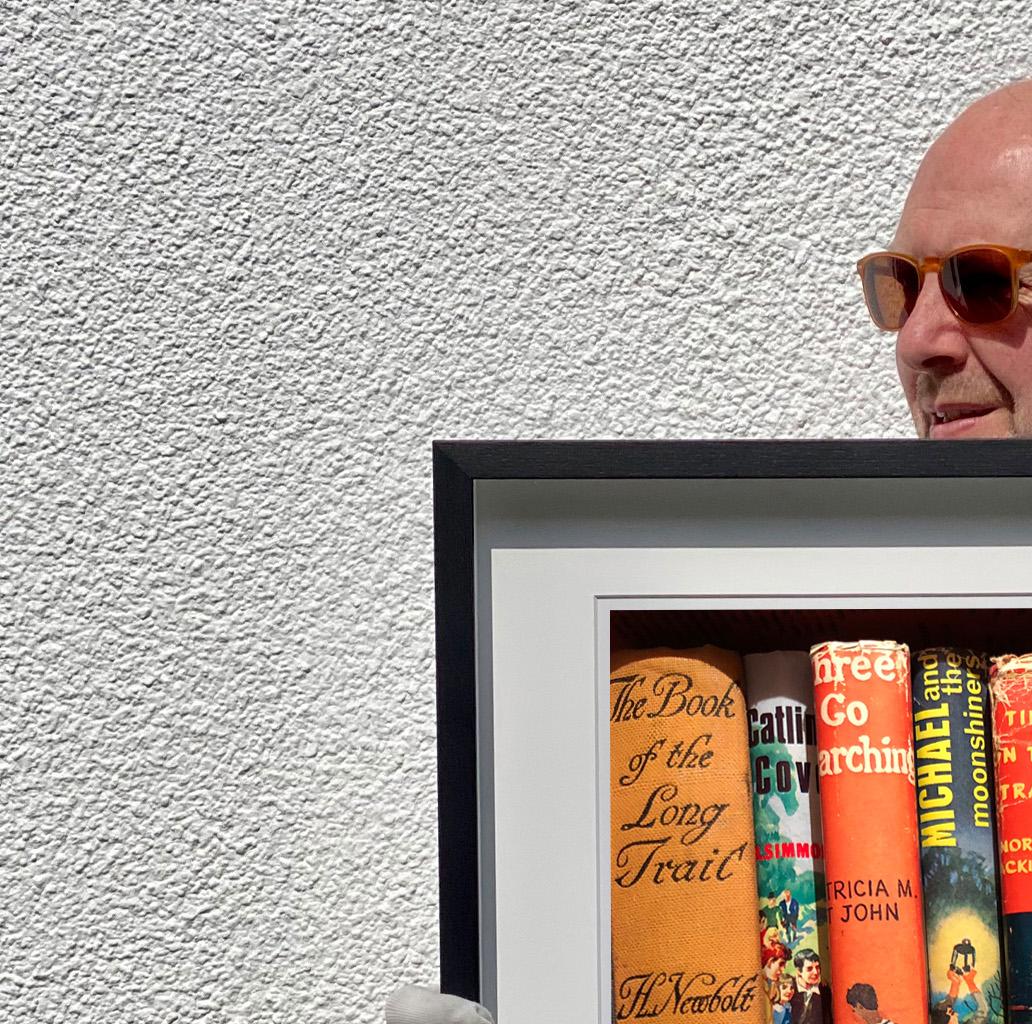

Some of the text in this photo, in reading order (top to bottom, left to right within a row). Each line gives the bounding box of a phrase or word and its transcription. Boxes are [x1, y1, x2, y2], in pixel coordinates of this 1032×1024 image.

[610, 671, 736, 723] The Book
[940, 649, 964, 697] the
[820, 692, 869, 727] Go
[619, 733, 714, 787] of the
[914, 651, 957, 849] MICHAEL and
[963, 653, 991, 829] moonshiners
[755, 755, 820, 794] Cov
[620, 783, 731, 847] Long
[615, 835, 749, 889] Trail
[840, 902, 900, 923] JOHN
[897, 879, 918, 899] M.
